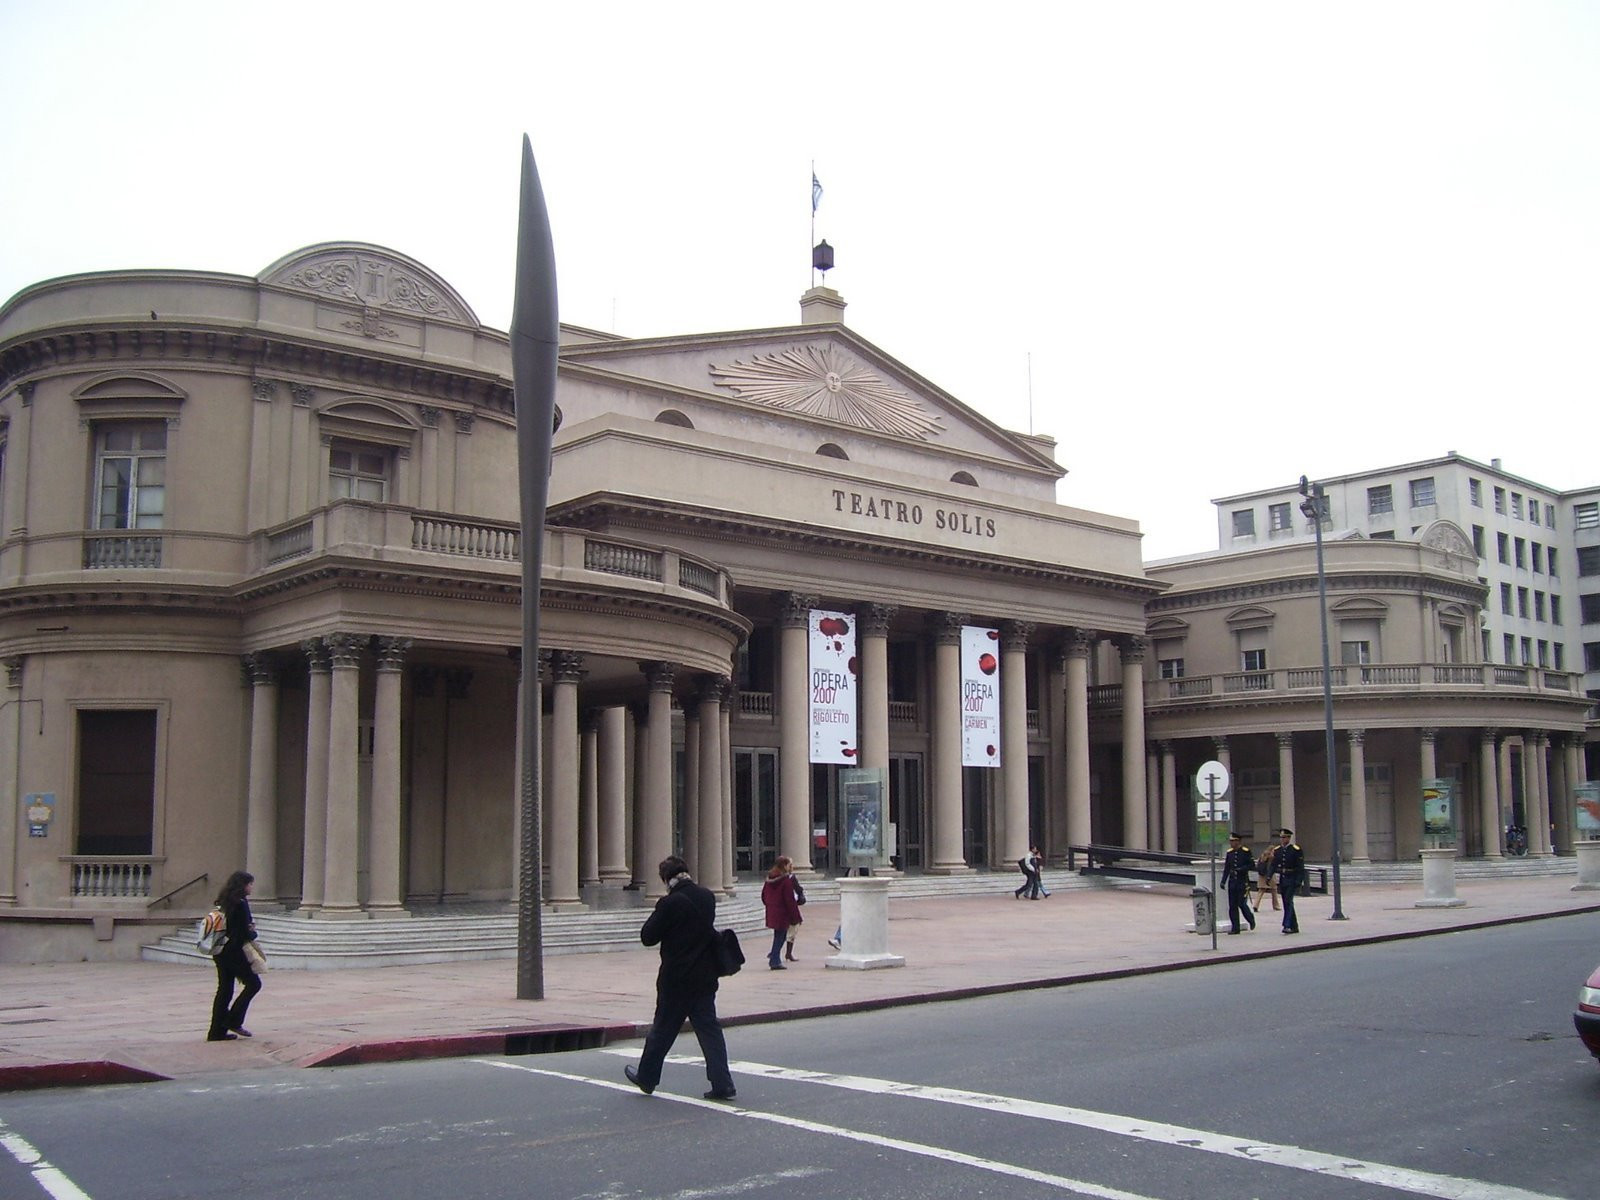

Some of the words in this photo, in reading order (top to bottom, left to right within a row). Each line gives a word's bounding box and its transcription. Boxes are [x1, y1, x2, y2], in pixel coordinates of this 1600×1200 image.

[832, 489, 923, 525] TEATRO
[935, 509, 996, 538] SOLIS
[813, 671, 848, 690] OPERA
[813, 687, 836, 704] 2007
[964, 682, 994, 699] OPERA
[964, 696, 984, 712] 2007
[813, 711, 849, 724] RIGOLETTO
[964, 718, 987, 729] CARMEN
